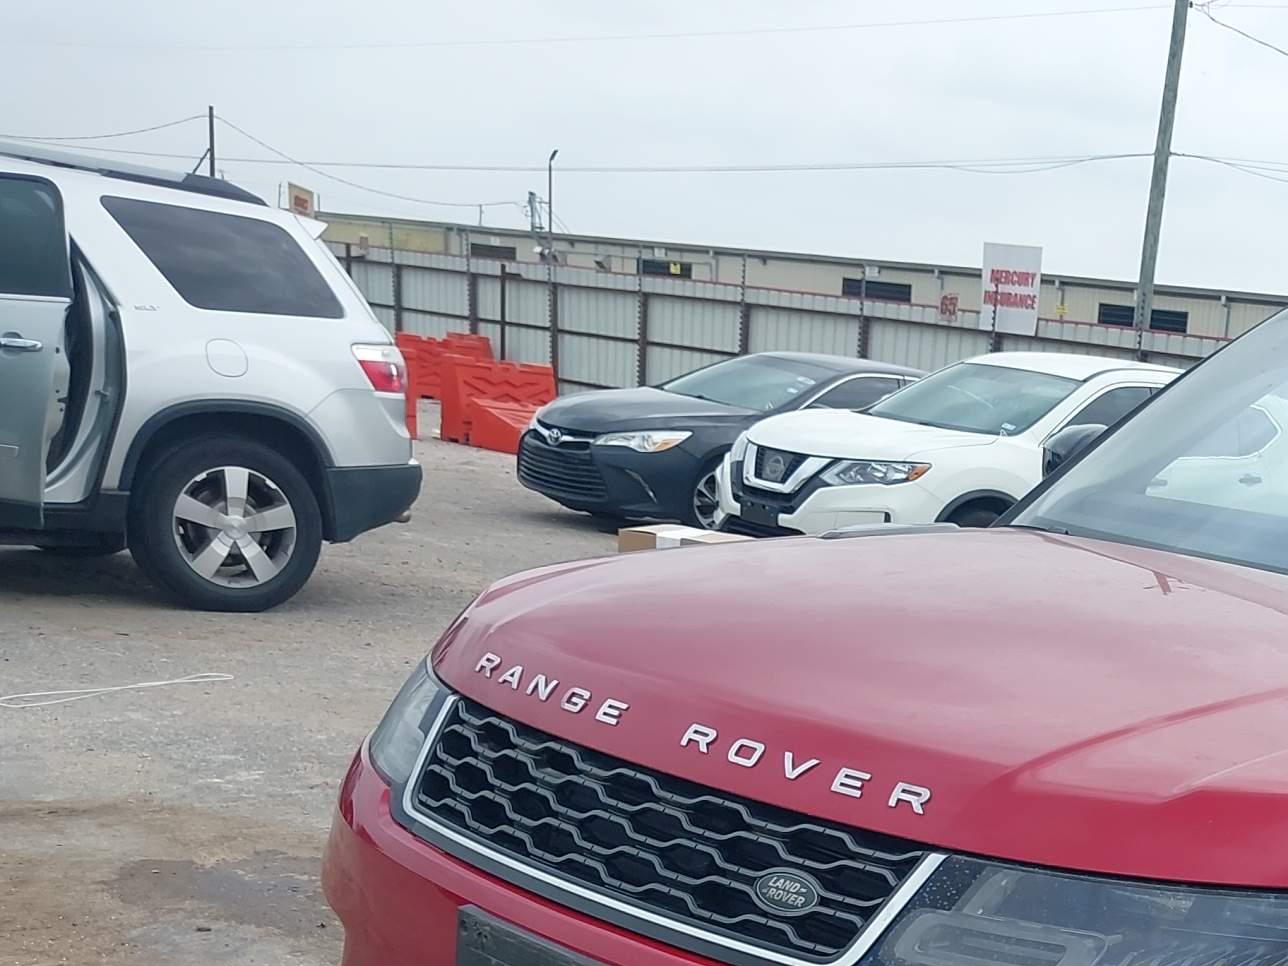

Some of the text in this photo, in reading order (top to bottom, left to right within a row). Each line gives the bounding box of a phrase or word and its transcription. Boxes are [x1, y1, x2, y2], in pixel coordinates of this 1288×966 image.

[990, 268, 1036, 288] MERCURY
[474, 652, 933, 816] RANGE ROVER
[767, 876, 801, 893] LAND
[766, 887, 806, 908] ROVER
